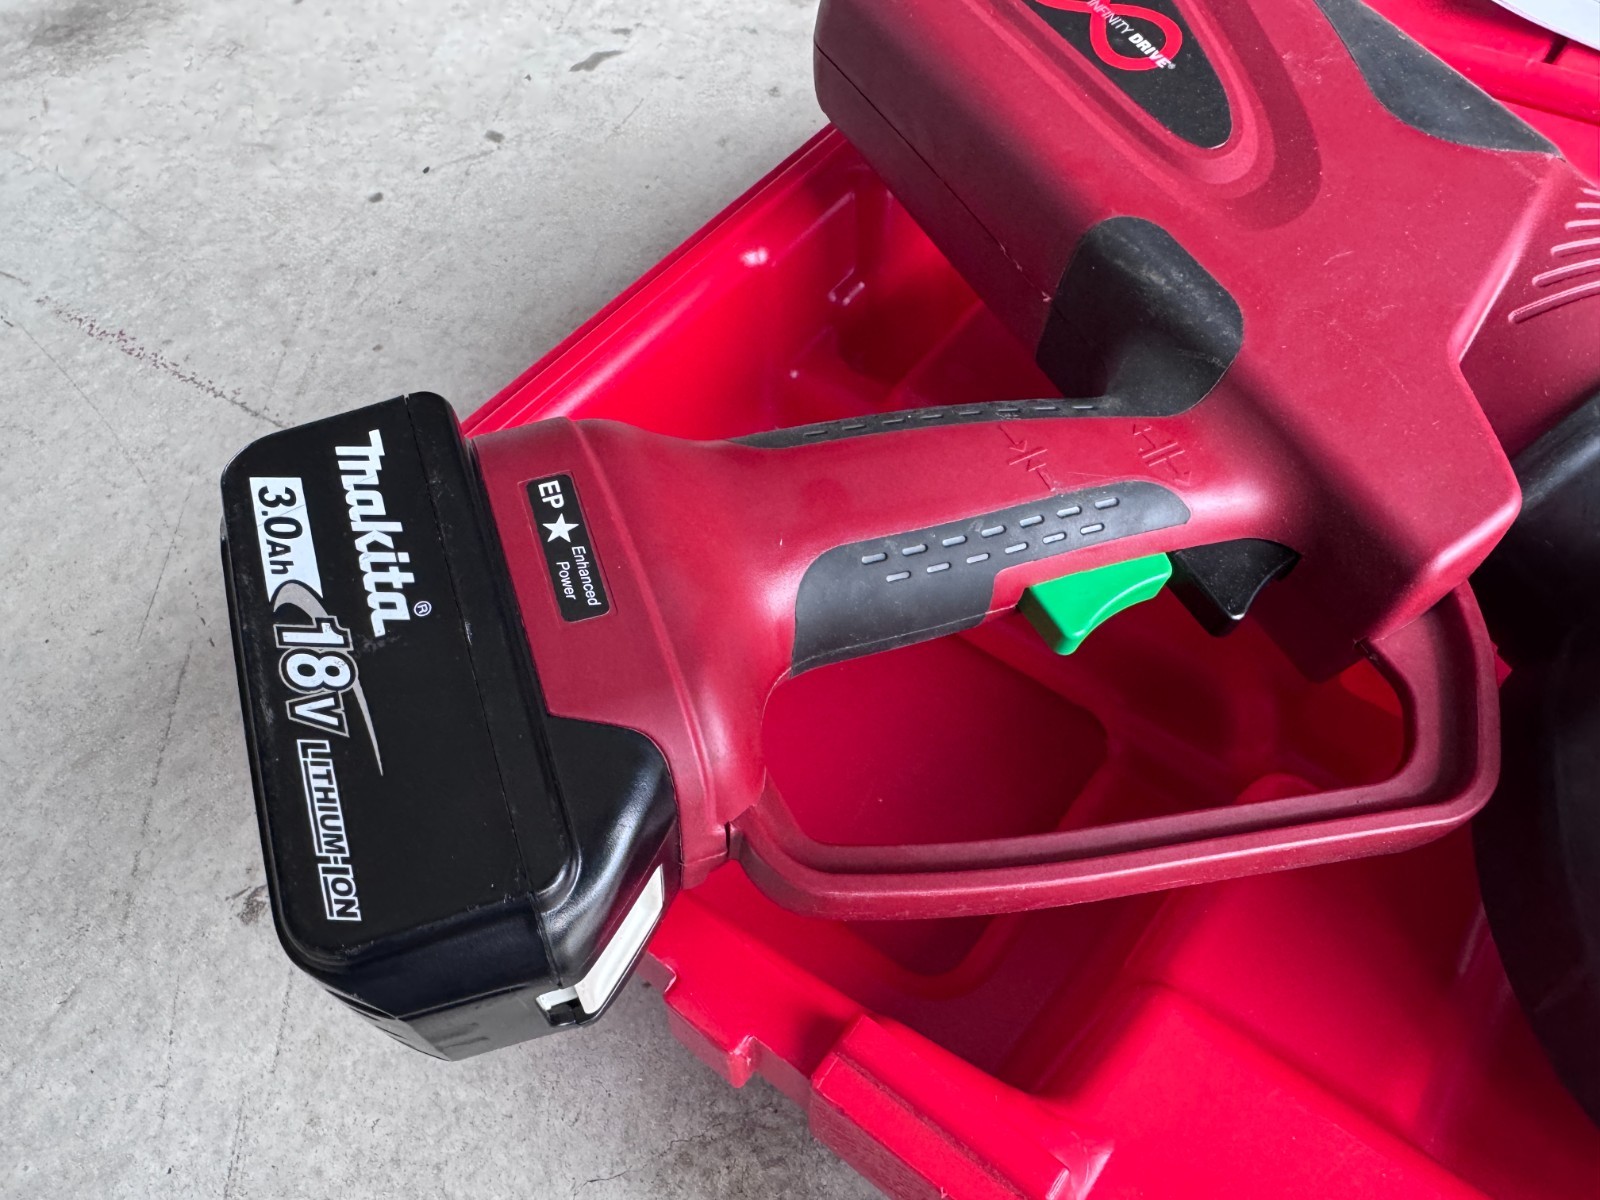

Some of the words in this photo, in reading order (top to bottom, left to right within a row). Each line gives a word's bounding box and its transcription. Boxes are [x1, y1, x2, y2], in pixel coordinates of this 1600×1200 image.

[1087, 0, 1134, 34] INFINITY
[538, 480, 564, 509] EP
[258, 486, 303, 575] 3.0Ah
[556, 561, 576, 600] Power
[571, 546, 602, 606] Enhanced
[273, 616, 358, 737] 18V
[297, 739, 361, 921] LITHIUM-ION
